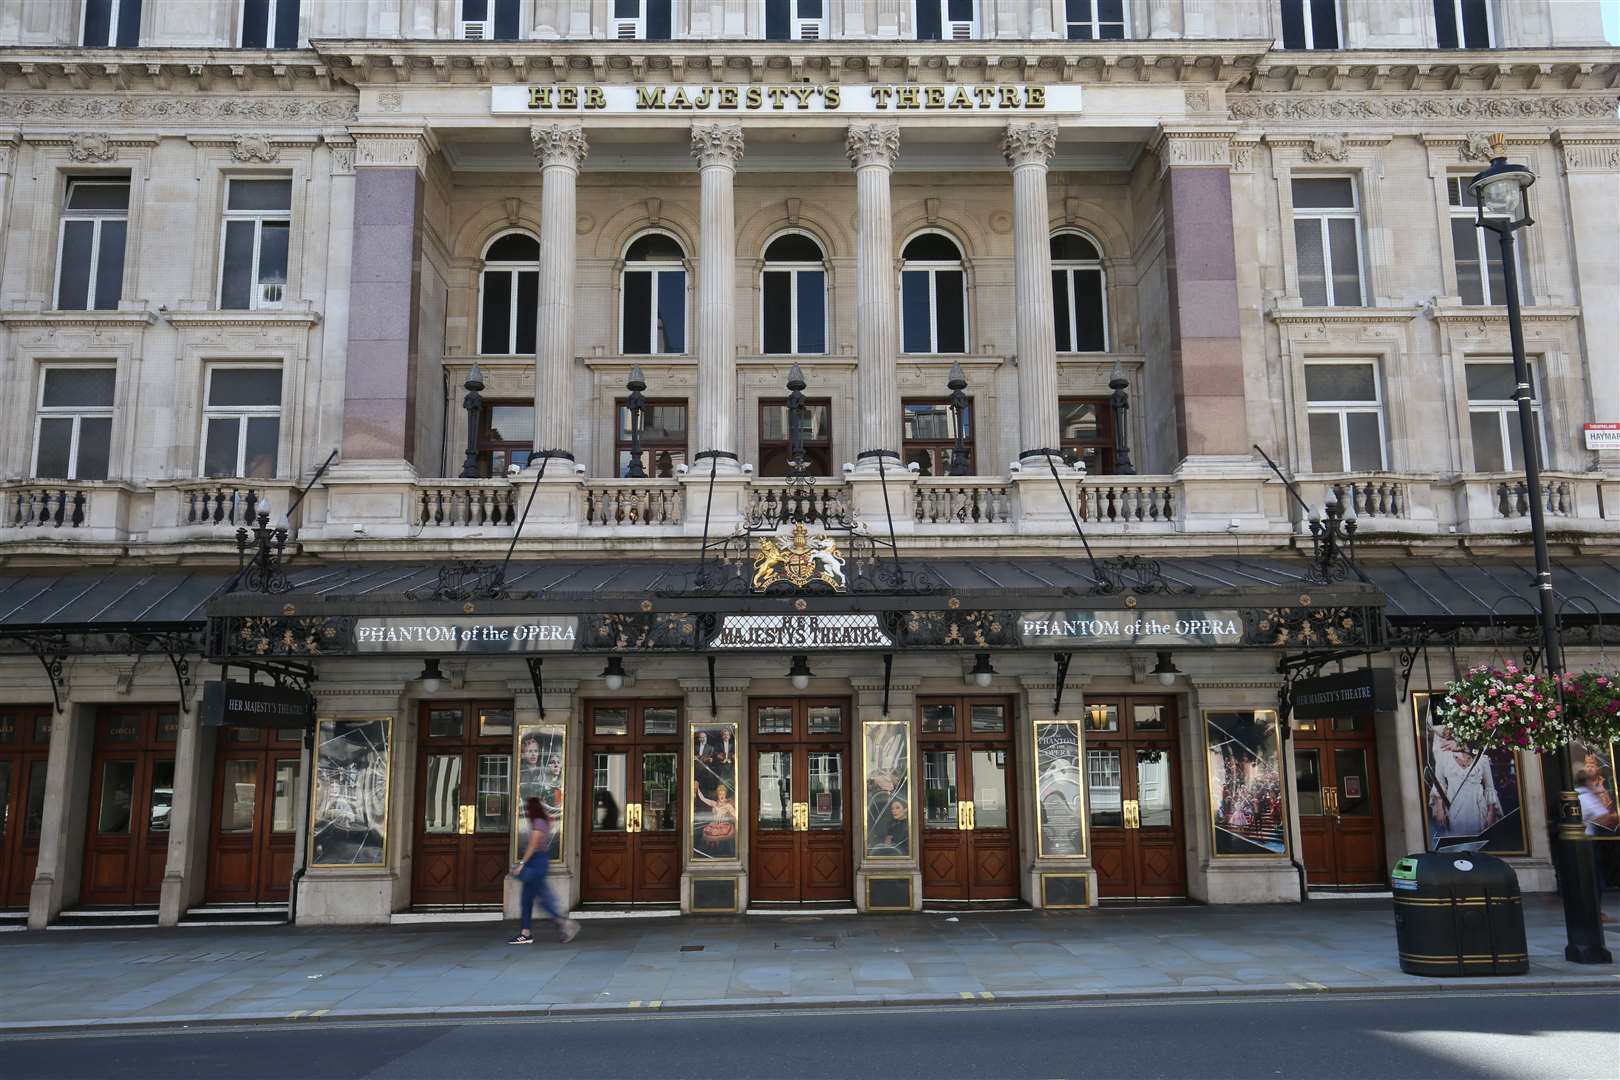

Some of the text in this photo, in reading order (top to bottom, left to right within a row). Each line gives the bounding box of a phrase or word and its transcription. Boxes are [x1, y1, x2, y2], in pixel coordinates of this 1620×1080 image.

[528, 86, 1046, 109] HER MAJESTY'S THEATRE
[783, 616, 819, 627] HER
[1023, 619, 1238, 636] PHANTOM of the OPERA
[358, 625, 577, 642] PHANTOM of the OPERA
[813, 627, 882, 645] THEATRE
[1309, 691, 1340, 705] MAJESTY'S
[1340, 686, 1371, 701] THEATRE
[229, 699, 242, 711] HER
[243, 701, 277, 713] MAJESTY'S
